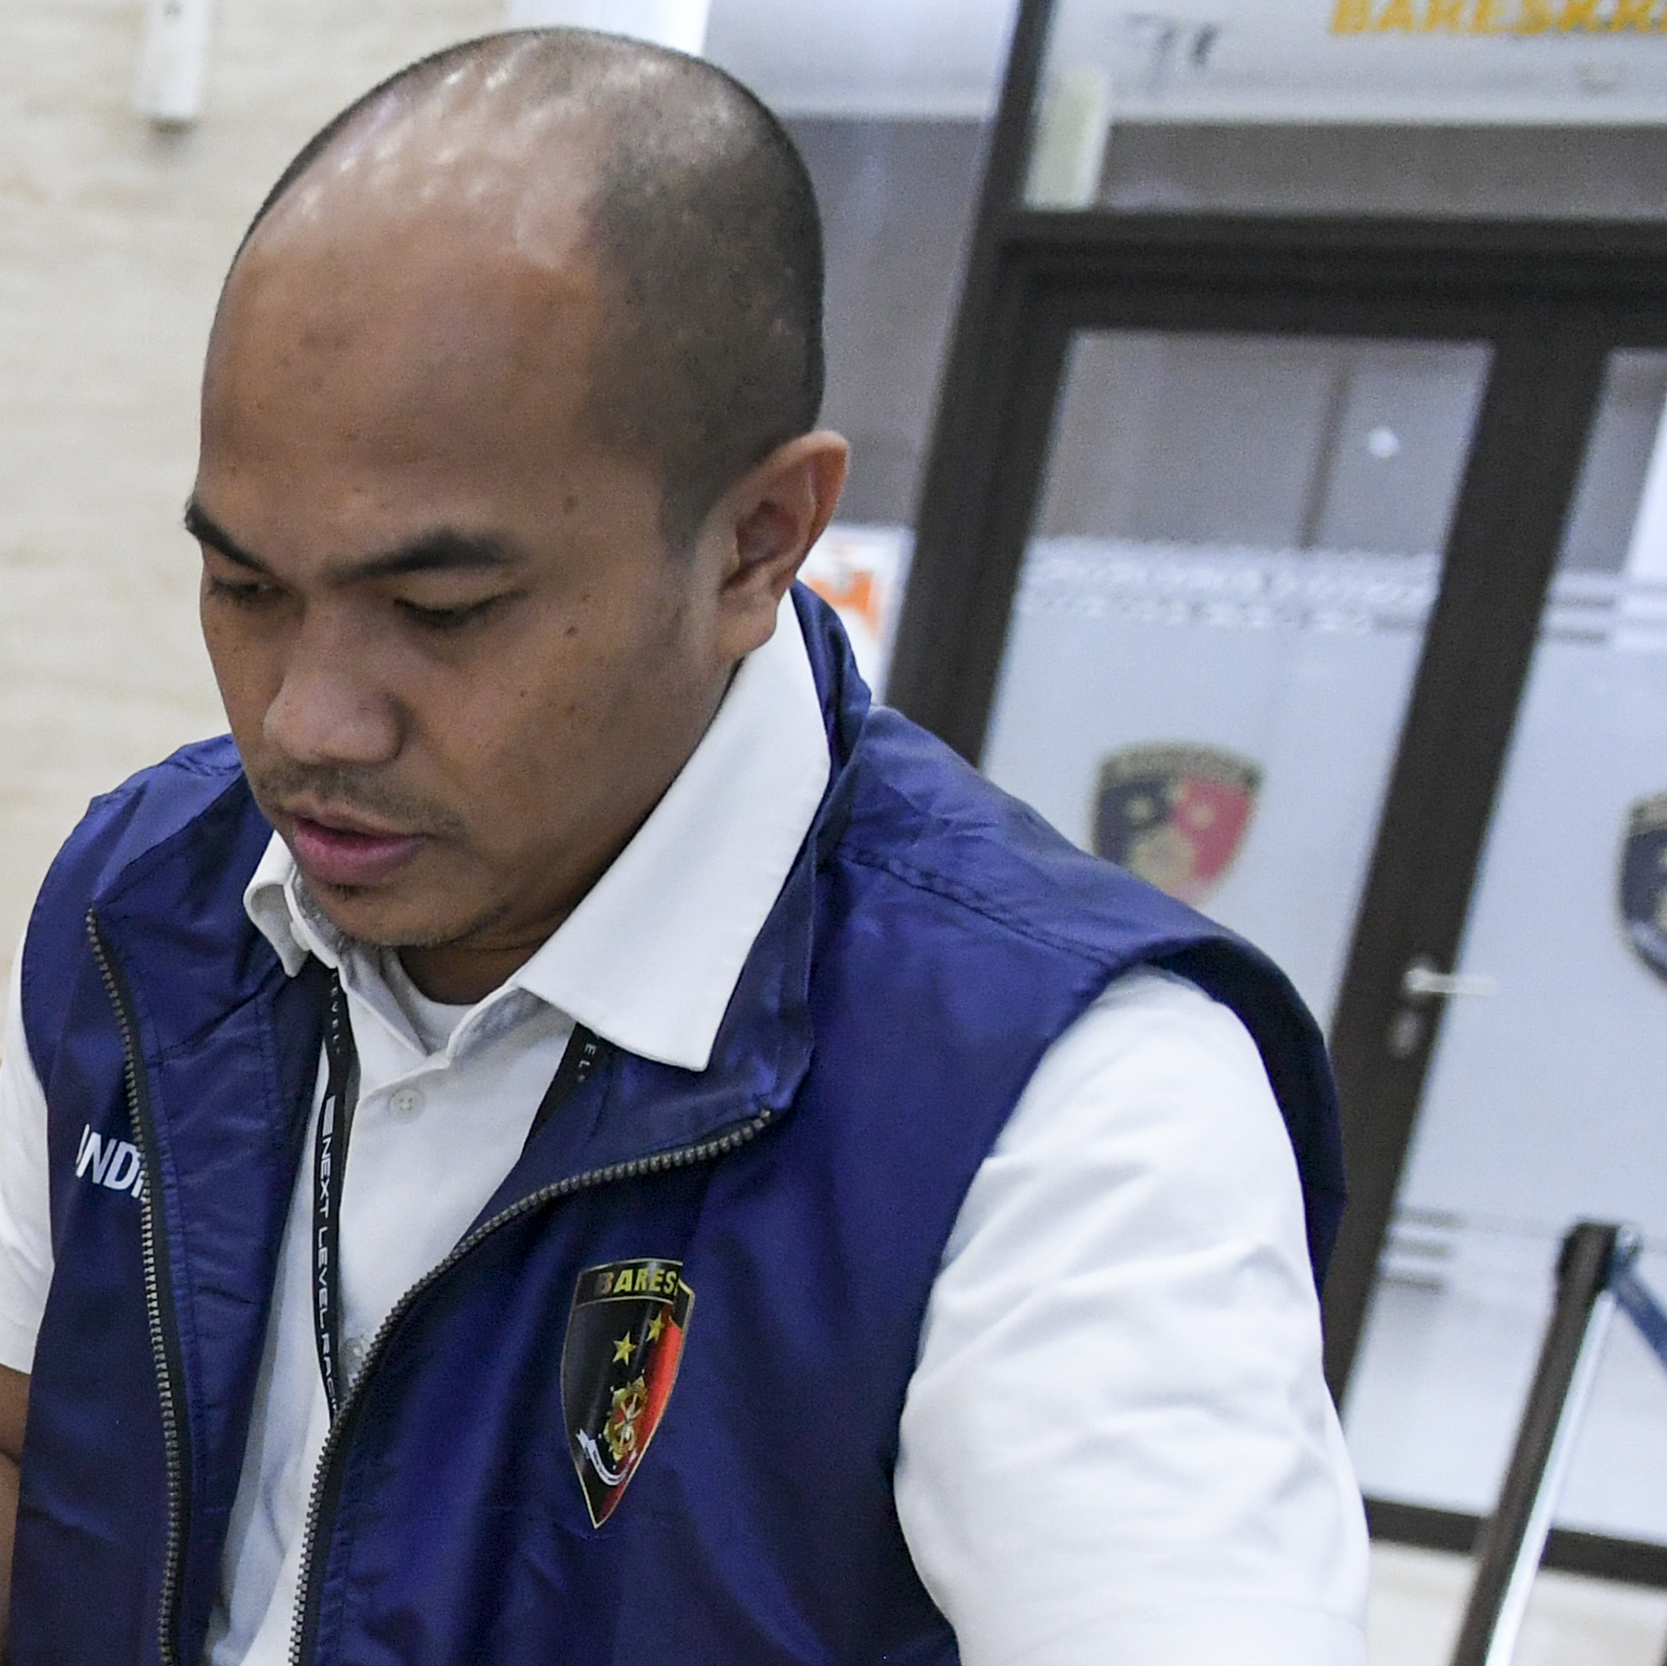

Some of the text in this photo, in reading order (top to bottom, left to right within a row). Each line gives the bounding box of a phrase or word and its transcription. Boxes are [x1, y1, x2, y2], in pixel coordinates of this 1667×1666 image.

[319, 1136, 332, 1218] NEXT
[318, 1226, 328, 1329] LEVEL
[595, 1268, 678, 1297] BARES
